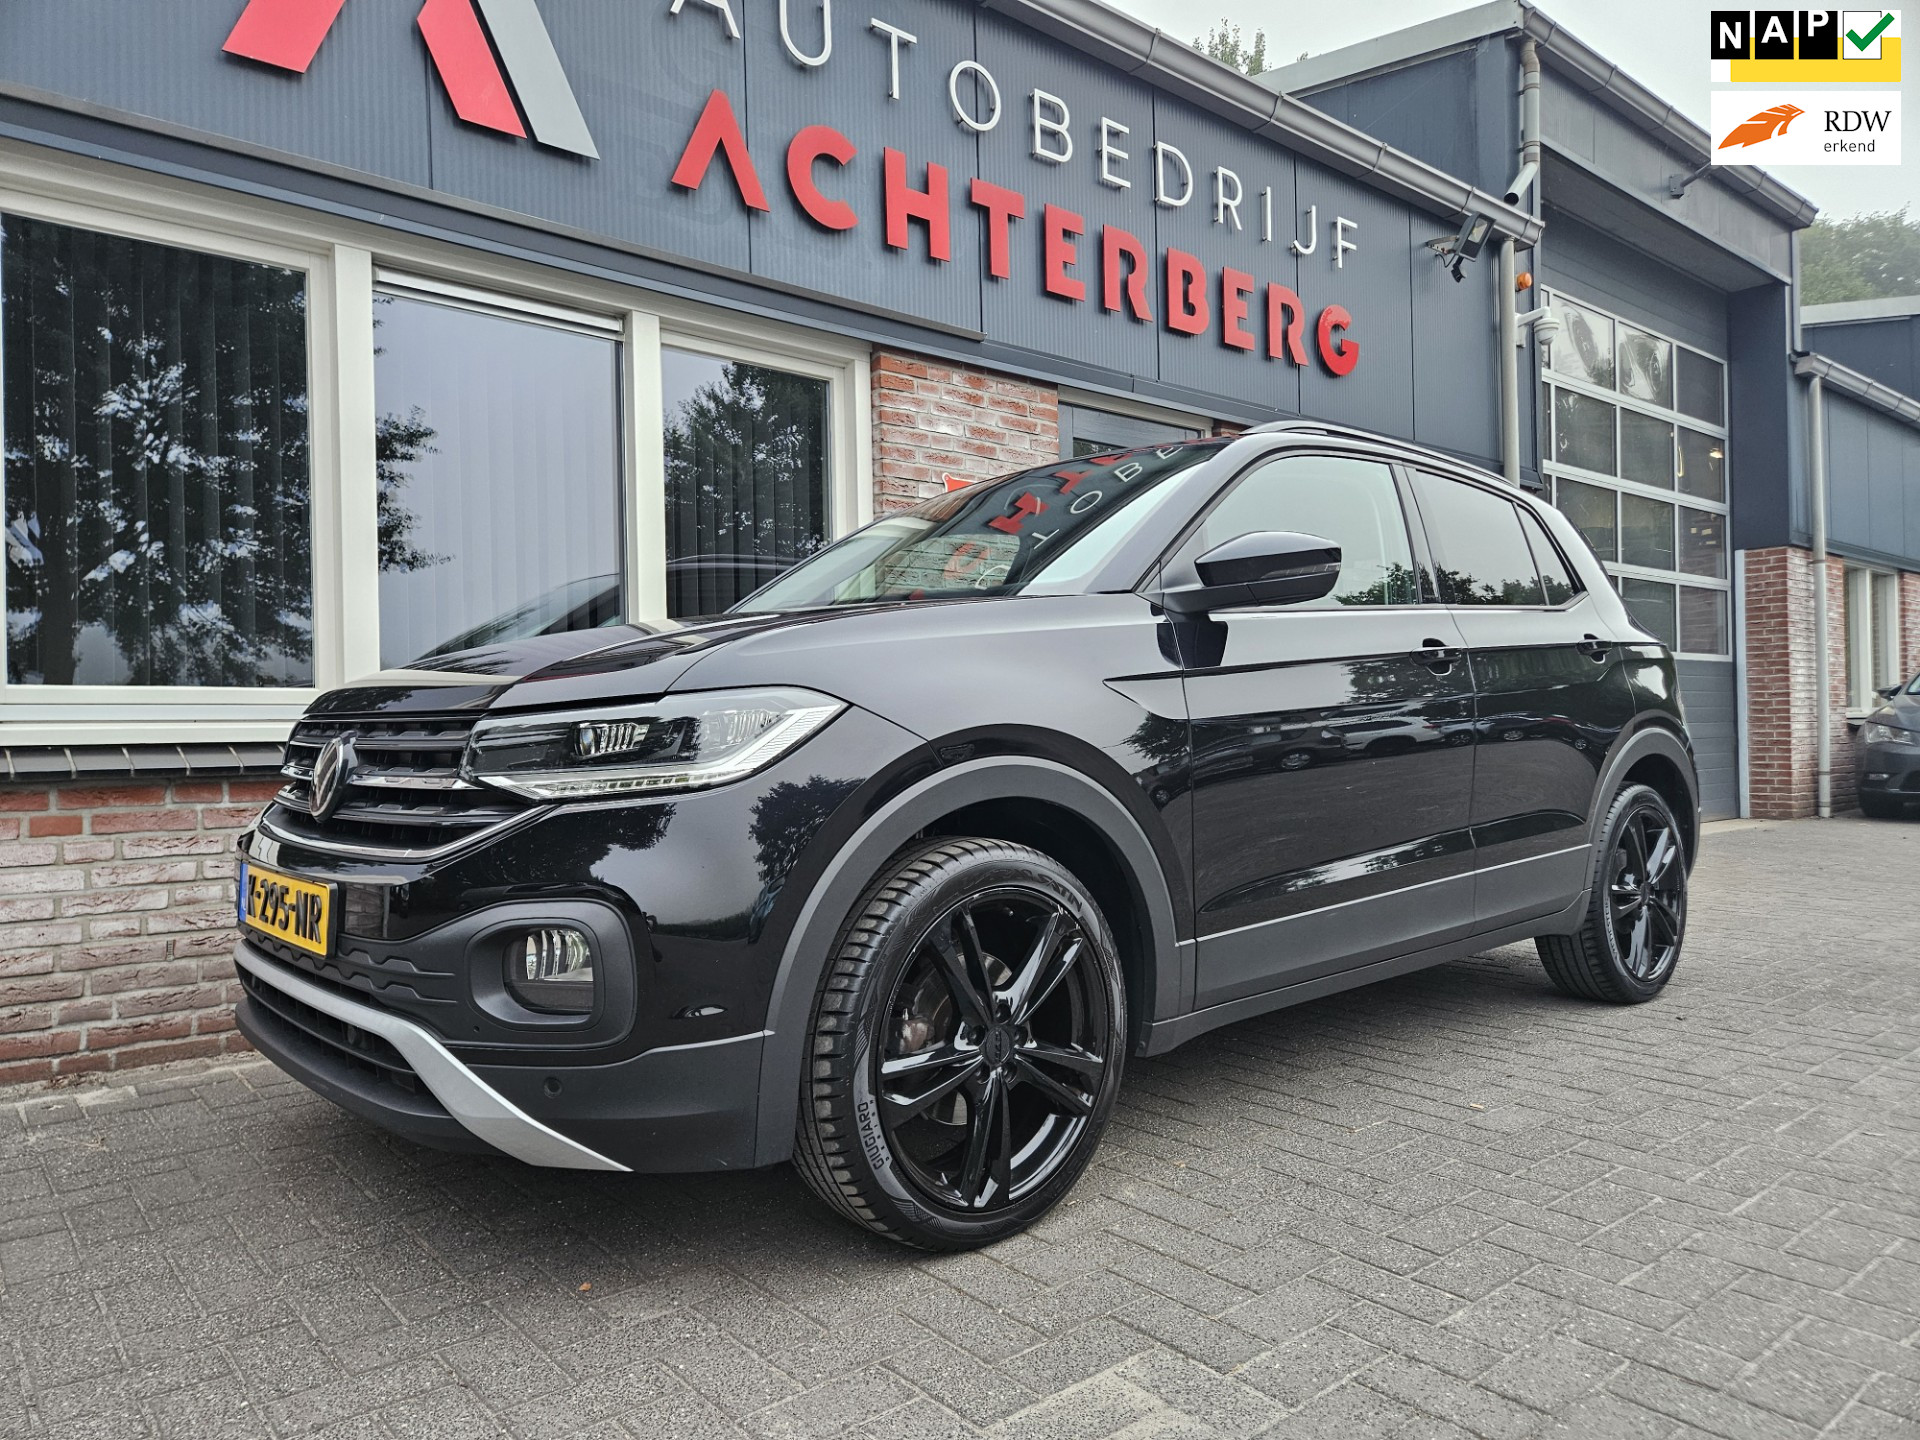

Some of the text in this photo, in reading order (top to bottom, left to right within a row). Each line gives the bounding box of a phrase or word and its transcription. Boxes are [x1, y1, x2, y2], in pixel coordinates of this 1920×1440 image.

[671, 88, 1359, 376] ACHTERBERG
[247, 873, 322, 944] K-295-NR
[857, 1101, 885, 1170] GIUGIARO
